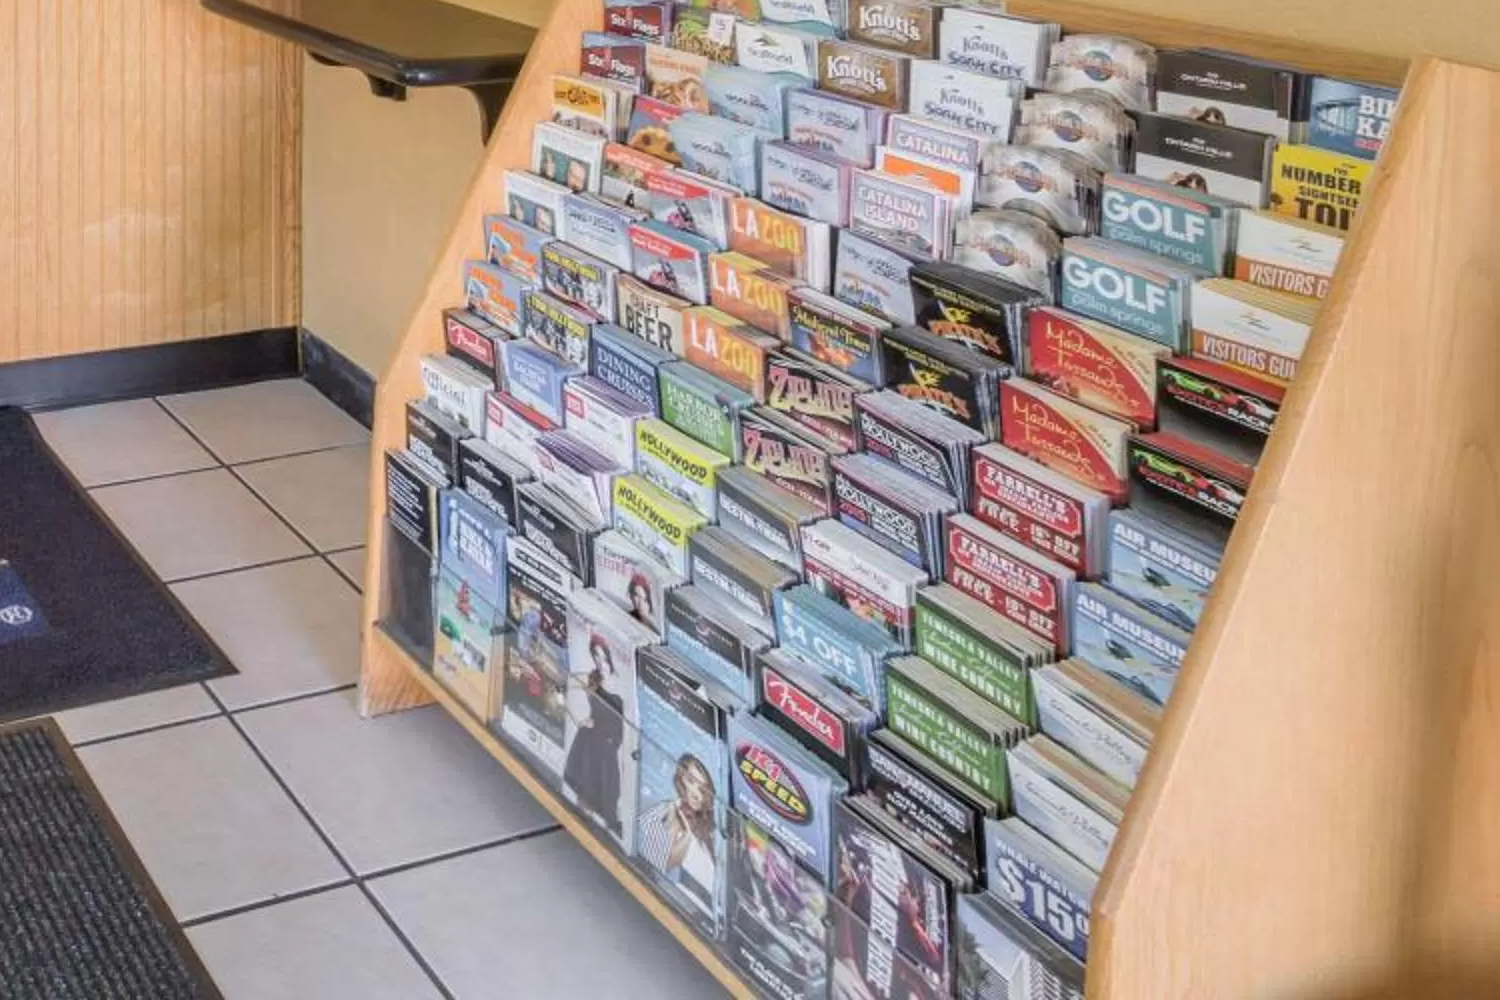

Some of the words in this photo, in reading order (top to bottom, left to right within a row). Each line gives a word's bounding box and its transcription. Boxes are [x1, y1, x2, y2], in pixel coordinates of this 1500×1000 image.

[858, 3, 921, 42] Knott's
[826, 55, 887, 93] Knott's
[896, 132, 969, 164] CATALINA
[1281, 163, 1362, 195] NUMBER
[858, 186, 926, 219] CATALINA
[1102, 190, 1205, 244] GOLF
[732, 202, 760, 240] LA
[759, 212, 801, 255] ZOO
[710, 259, 741, 300] LA
[740, 274, 785, 319] ZOO
[1063, 255, 1167, 315] GOLF
[1248, 262, 1316, 297] VISITORS
[625, 302, 673, 351] BEER
[688, 316, 719, 362] LA
[718, 334, 758, 380] ZOO
[1202, 335, 1267, 373] VISITORS
[639, 429, 708, 480] HOLLYWOOD
[617, 485, 682, 540] HOLLYWOOD
[1113, 523, 1146, 547] AIR
[1076, 593, 1108, 619] AIR
[812, 634, 858, 676] OFF
[768, 680, 836, 741] Fender
[740, 758, 807, 816] SPEED
